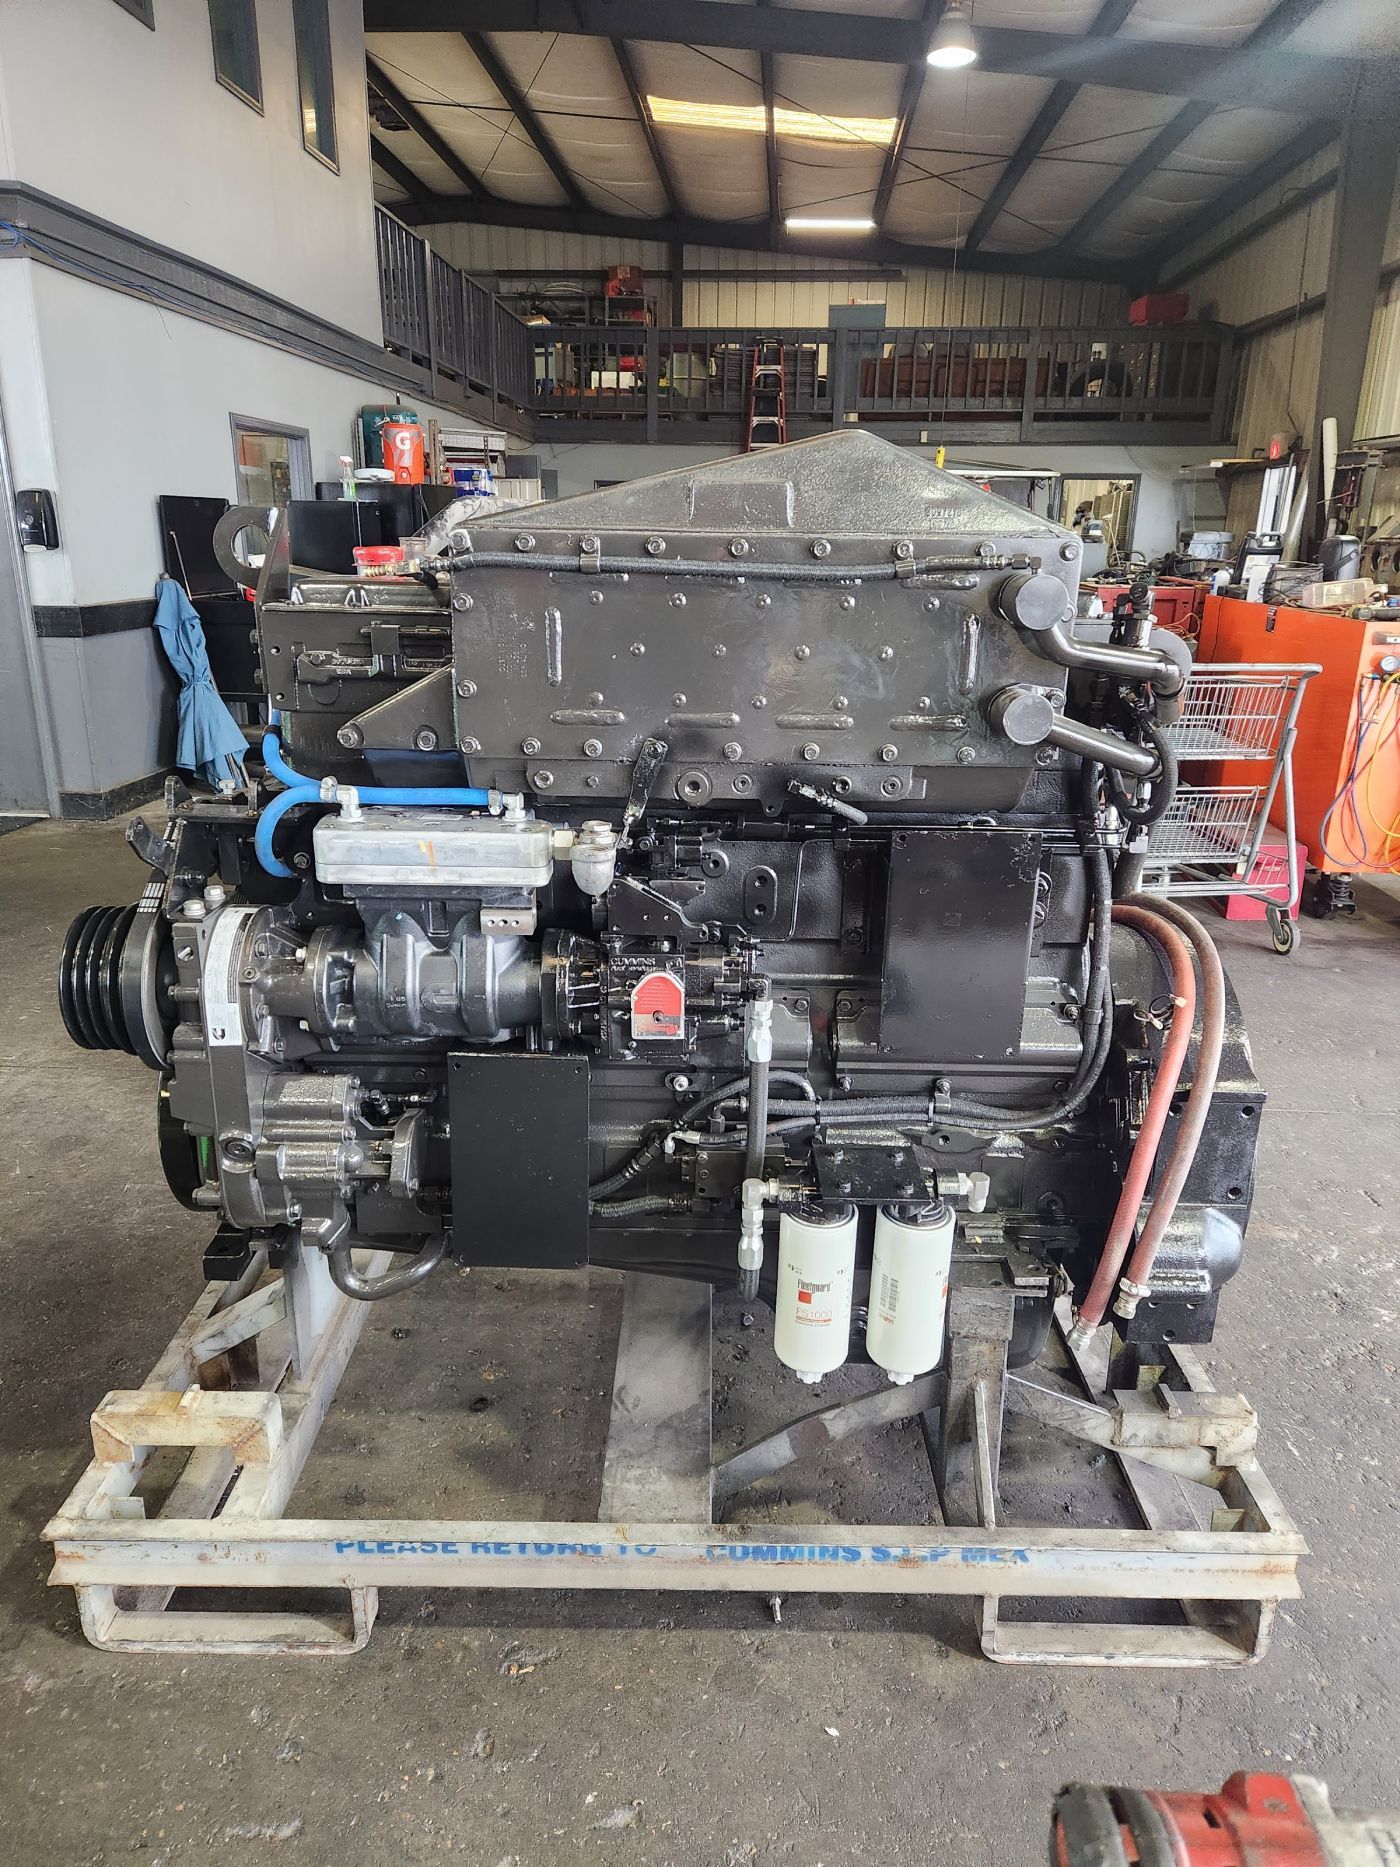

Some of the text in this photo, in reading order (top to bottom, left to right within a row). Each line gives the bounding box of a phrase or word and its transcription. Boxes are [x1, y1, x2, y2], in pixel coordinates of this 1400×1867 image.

[395, 432, 411, 450] G
[797, 1278, 832, 1295] Fleetguard
[335, 1541, 459, 1555] PLEASE
[705, 1545, 862, 1563] CUMMINS
